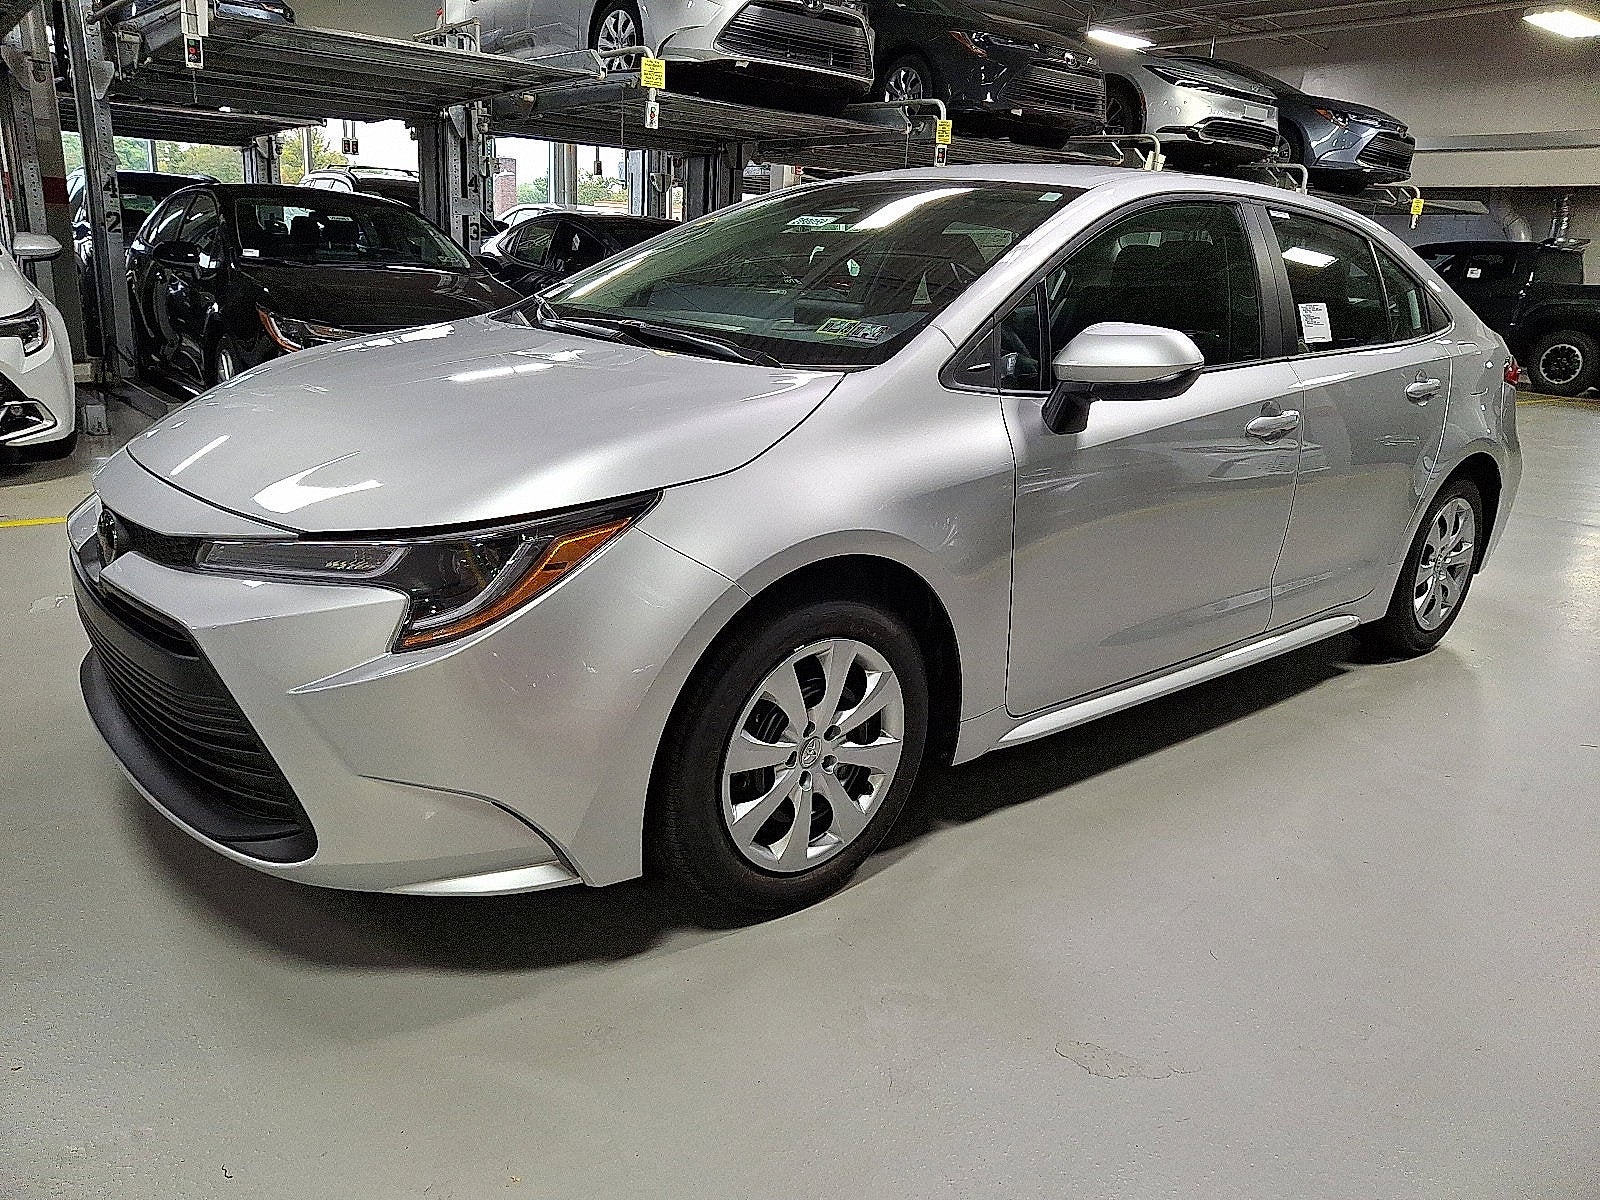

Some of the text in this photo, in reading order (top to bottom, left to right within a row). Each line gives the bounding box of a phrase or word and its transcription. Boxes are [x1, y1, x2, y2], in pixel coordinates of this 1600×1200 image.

[103, 176, 118, 198] 4
[105, 211, 121, 233] 2
[470, 222, 480, 241] 3
